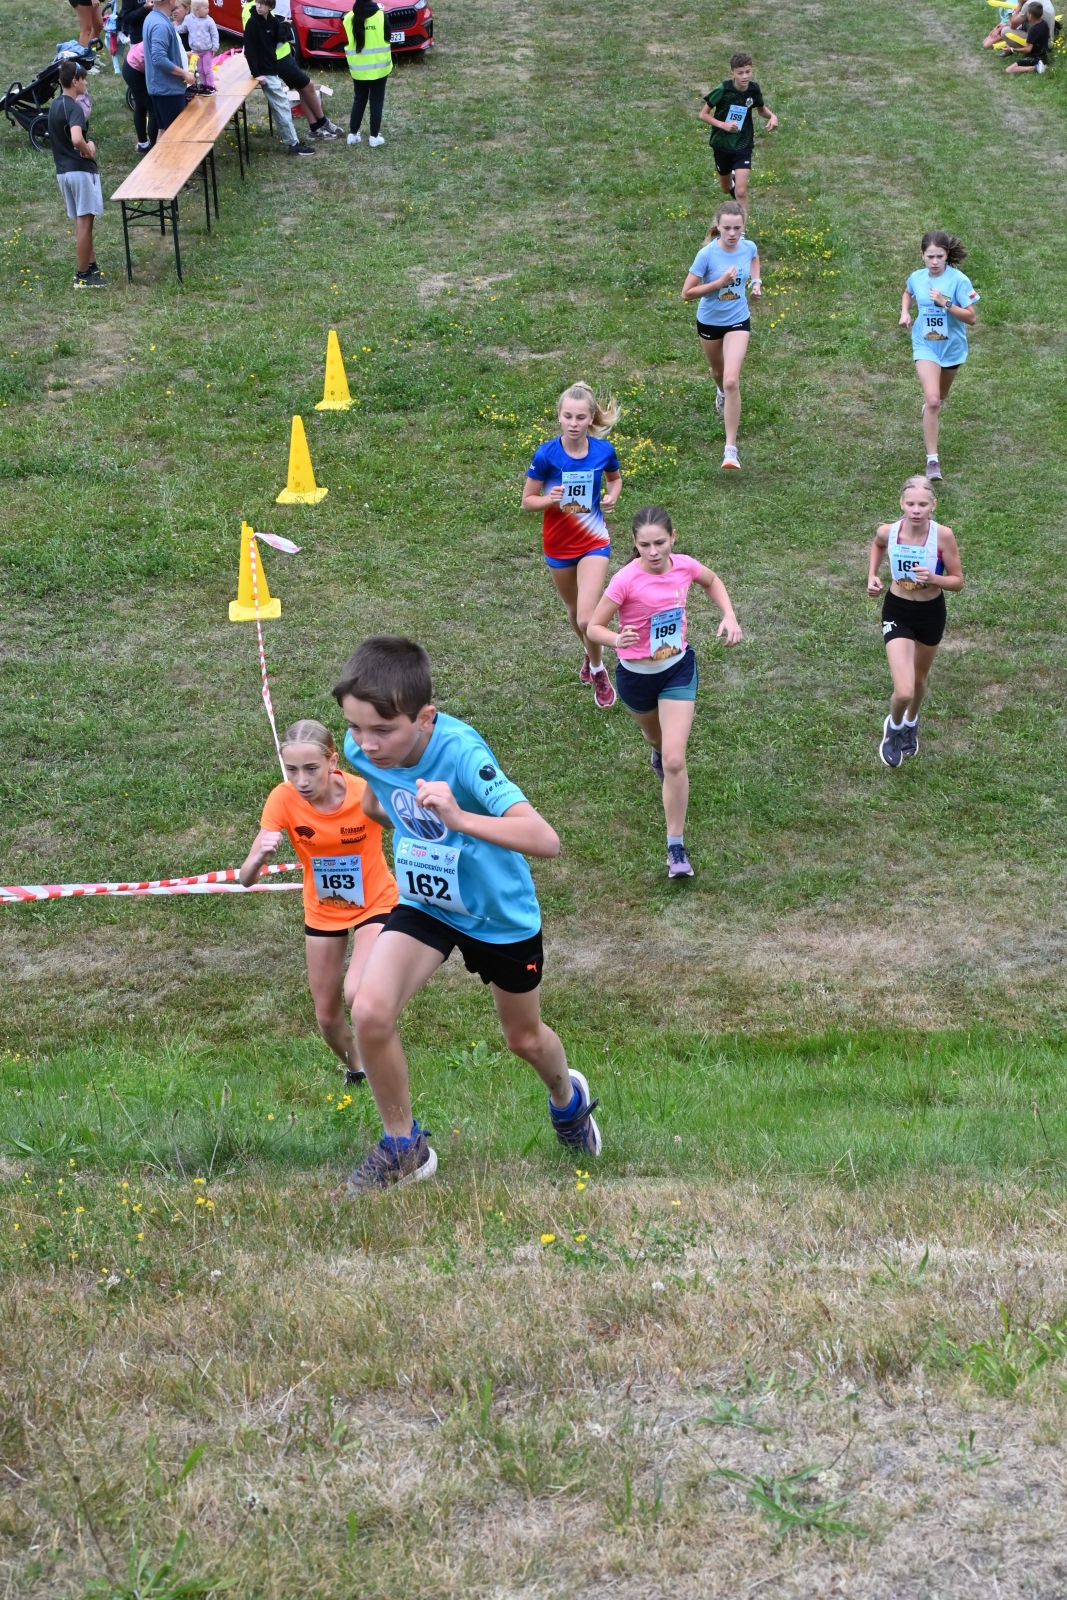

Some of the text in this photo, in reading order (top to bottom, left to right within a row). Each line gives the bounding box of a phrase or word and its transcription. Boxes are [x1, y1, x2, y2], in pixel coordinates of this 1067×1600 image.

[926, 317, 943, 327] 156
[568, 485, 586, 496] 161
[655, 623, 677, 639] 199
[411, 848, 427, 857] CUP
[321, 874, 355, 889] 163
[406, 871, 452, 901] 162
